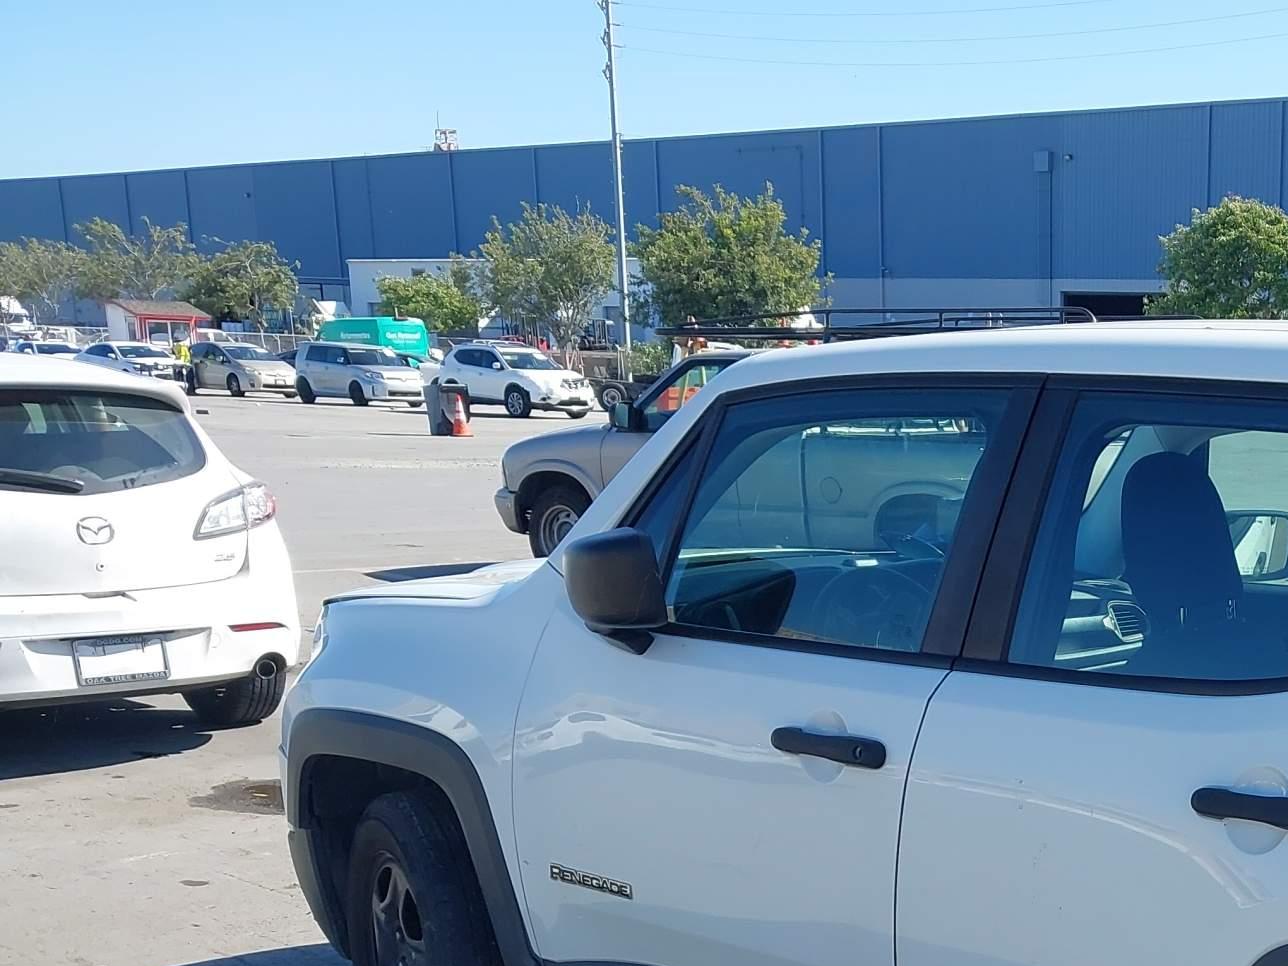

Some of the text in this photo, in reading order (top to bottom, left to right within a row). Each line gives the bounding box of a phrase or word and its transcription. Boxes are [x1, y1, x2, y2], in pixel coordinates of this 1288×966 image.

[87, 677, 106, 685] OAK
[135, 671, 166, 681] MAZDA
[549, 862, 633, 900] RENEGADE
